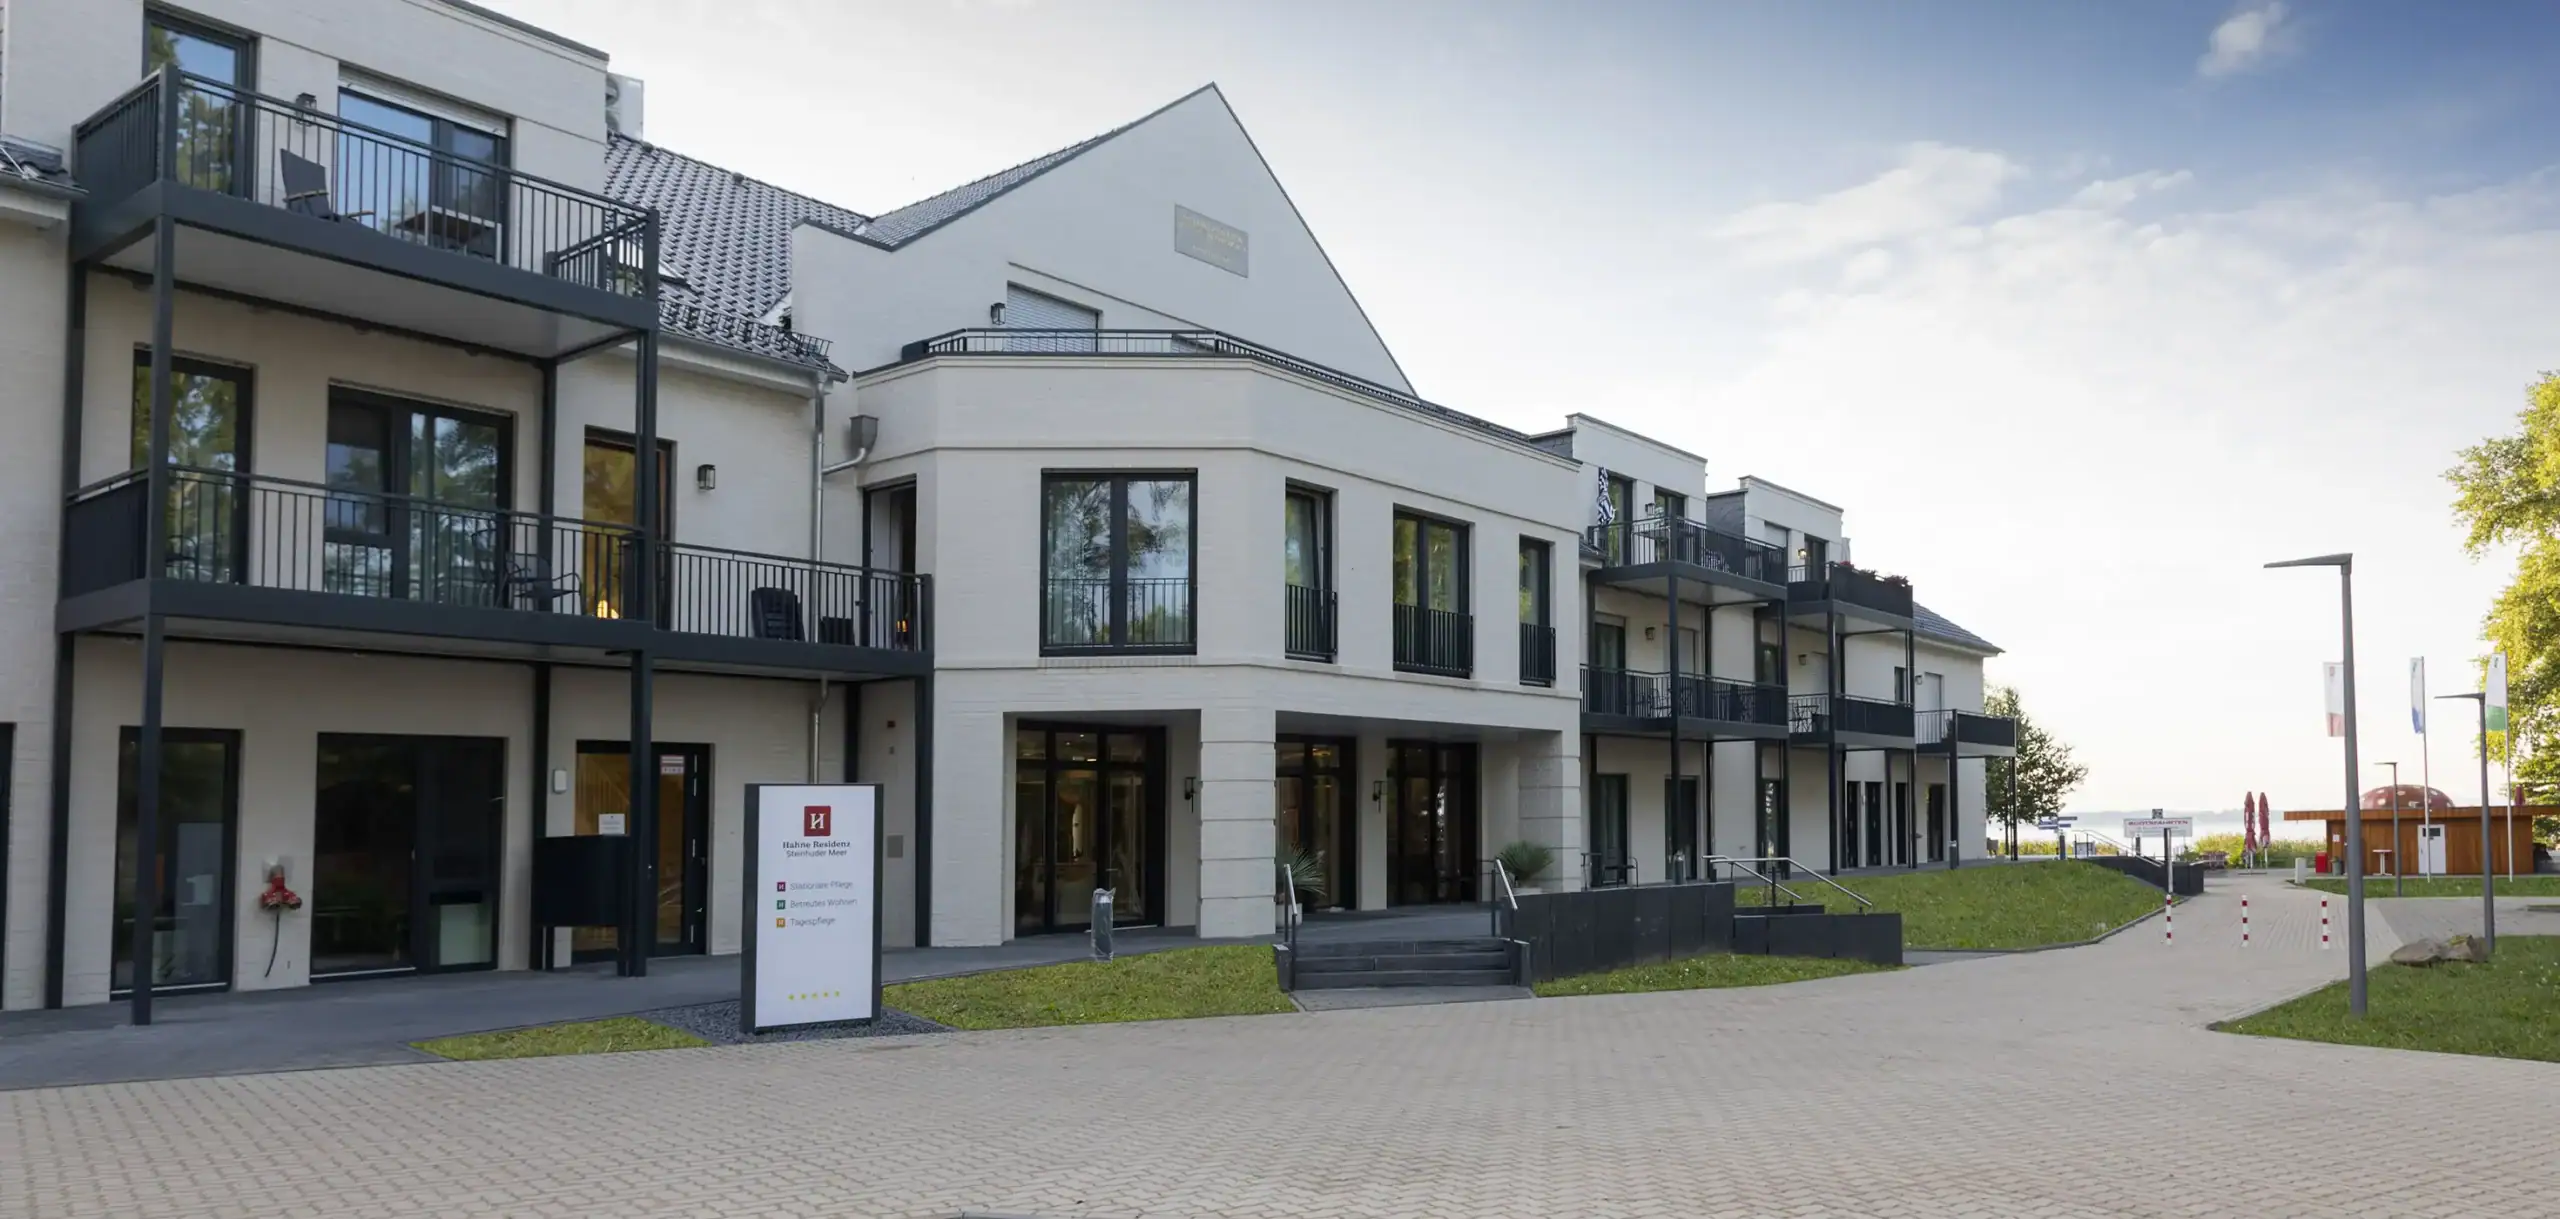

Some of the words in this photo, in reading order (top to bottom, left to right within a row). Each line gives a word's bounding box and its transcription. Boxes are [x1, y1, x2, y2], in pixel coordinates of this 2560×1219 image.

[782, 841, 811, 849] Hahne
[813, 840, 851, 848] Residenz
[786, 850, 827, 858] Steinhuder
[828, 849, 847, 857] Meer
[827, 898, 858, 906] Wohnen
